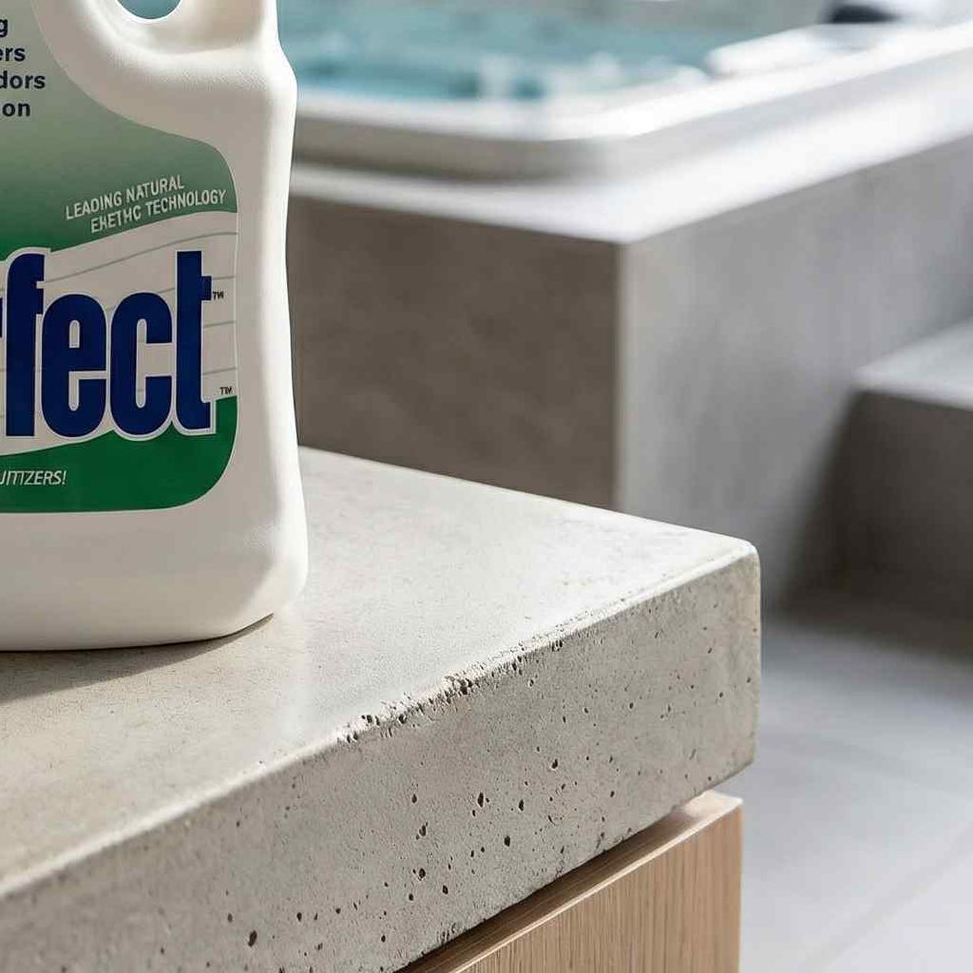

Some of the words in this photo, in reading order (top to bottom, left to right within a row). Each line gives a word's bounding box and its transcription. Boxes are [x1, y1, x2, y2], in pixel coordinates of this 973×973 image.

[65, 190, 123, 220] LEADING
[126, 175, 185, 202] NATURAL
[145, 189, 227, 217] TECHNOLOGY
